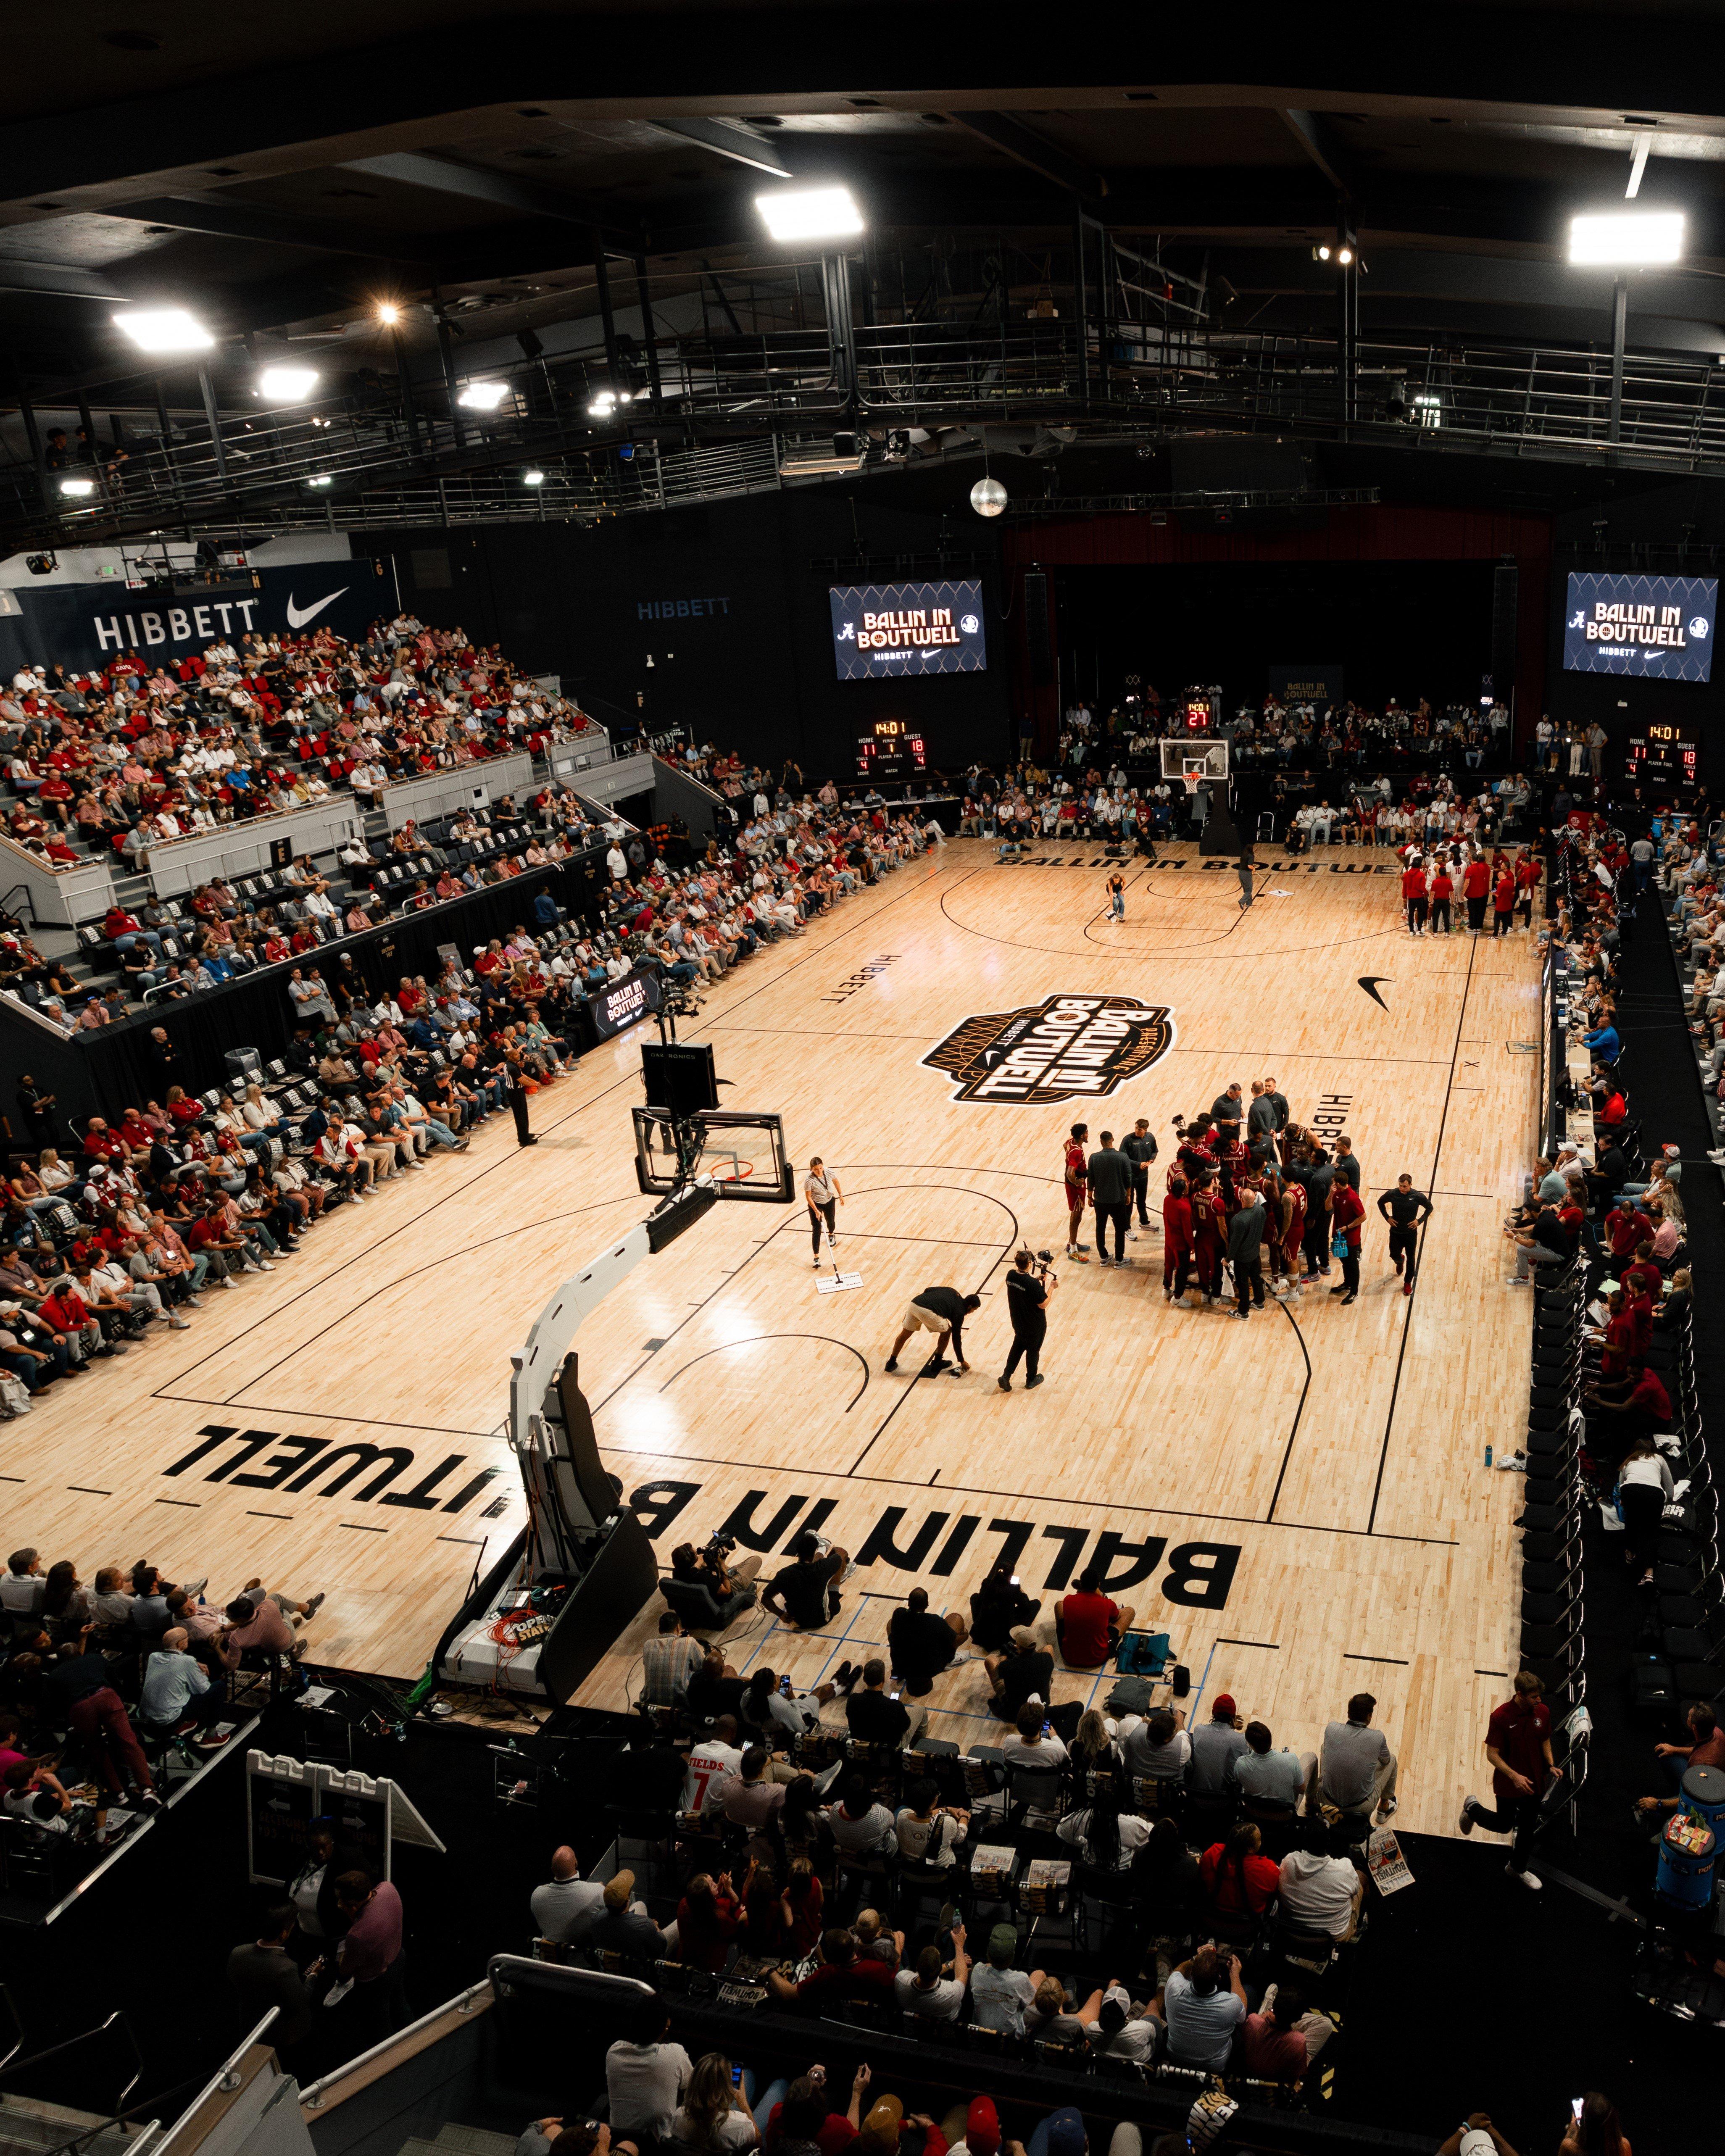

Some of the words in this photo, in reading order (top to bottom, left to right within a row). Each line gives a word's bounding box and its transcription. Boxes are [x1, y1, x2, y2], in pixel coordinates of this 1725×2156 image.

[377, 564, 383, 575] G
[252, 576, 260, 588] H
[637, 597, 730, 620] HIBBETT
[1596, 603, 1655, 624] BALLIN
[1662, 606, 1680, 626] IN
[94, 599, 253, 650] HIBBETT
[864, 610, 926, 629] BALLIN
[932, 608, 951, 626] IN
[857, 626, 960, 648] BOUTWELL
[1587, 622, 1686, 647] BOUTWELL
[874, 651, 913, 660] HIBBETT
[1599, 647, 1637, 656] HIBBETT
[637, 697, 643, 706] F
[1189, 703, 1209, 711] 14:01
[1189, 711, 1206, 726] 27
[864, 744, 875, 755] 11
[890, 744, 893, 752] 1
[913, 740, 923, 751] 18
[1635, 747, 1646, 758] 11
[1661, 750, 1664, 759] 1
[1684, 751, 1695, 764] 18
[1630, 764, 1635, 772] 4
[1688, 770, 1694, 779] 4
[279, 848, 285, 862] E
[994, 857, 1132, 868] BALLIN
[1144, 859, 1186, 869] IN
[382, 945, 395, 954] SECTION
[820, 955, 903, 1003] HIBBETT
[607, 985, 633, 1008] BALLIN
[632, 980, 642, 993] IN
[1003, 1019, 1030, 1047] HIBBETT
[1060, 1009, 1155, 1066] BALLIN
[973, 998, 1094, 1096] BOUTWELL
[1043, 1069, 1108, 1091] IN
[1300, 1195, 1305, 1211] 5
[1198, 1205, 1206, 1219] 0
[719, 1490, 840, 1557] IN
[856, 1506, 1243, 1611] BALLIN
[692, 1772, 710, 1811] 7
[1373, 1861, 1406, 1882] BOUTWELL
